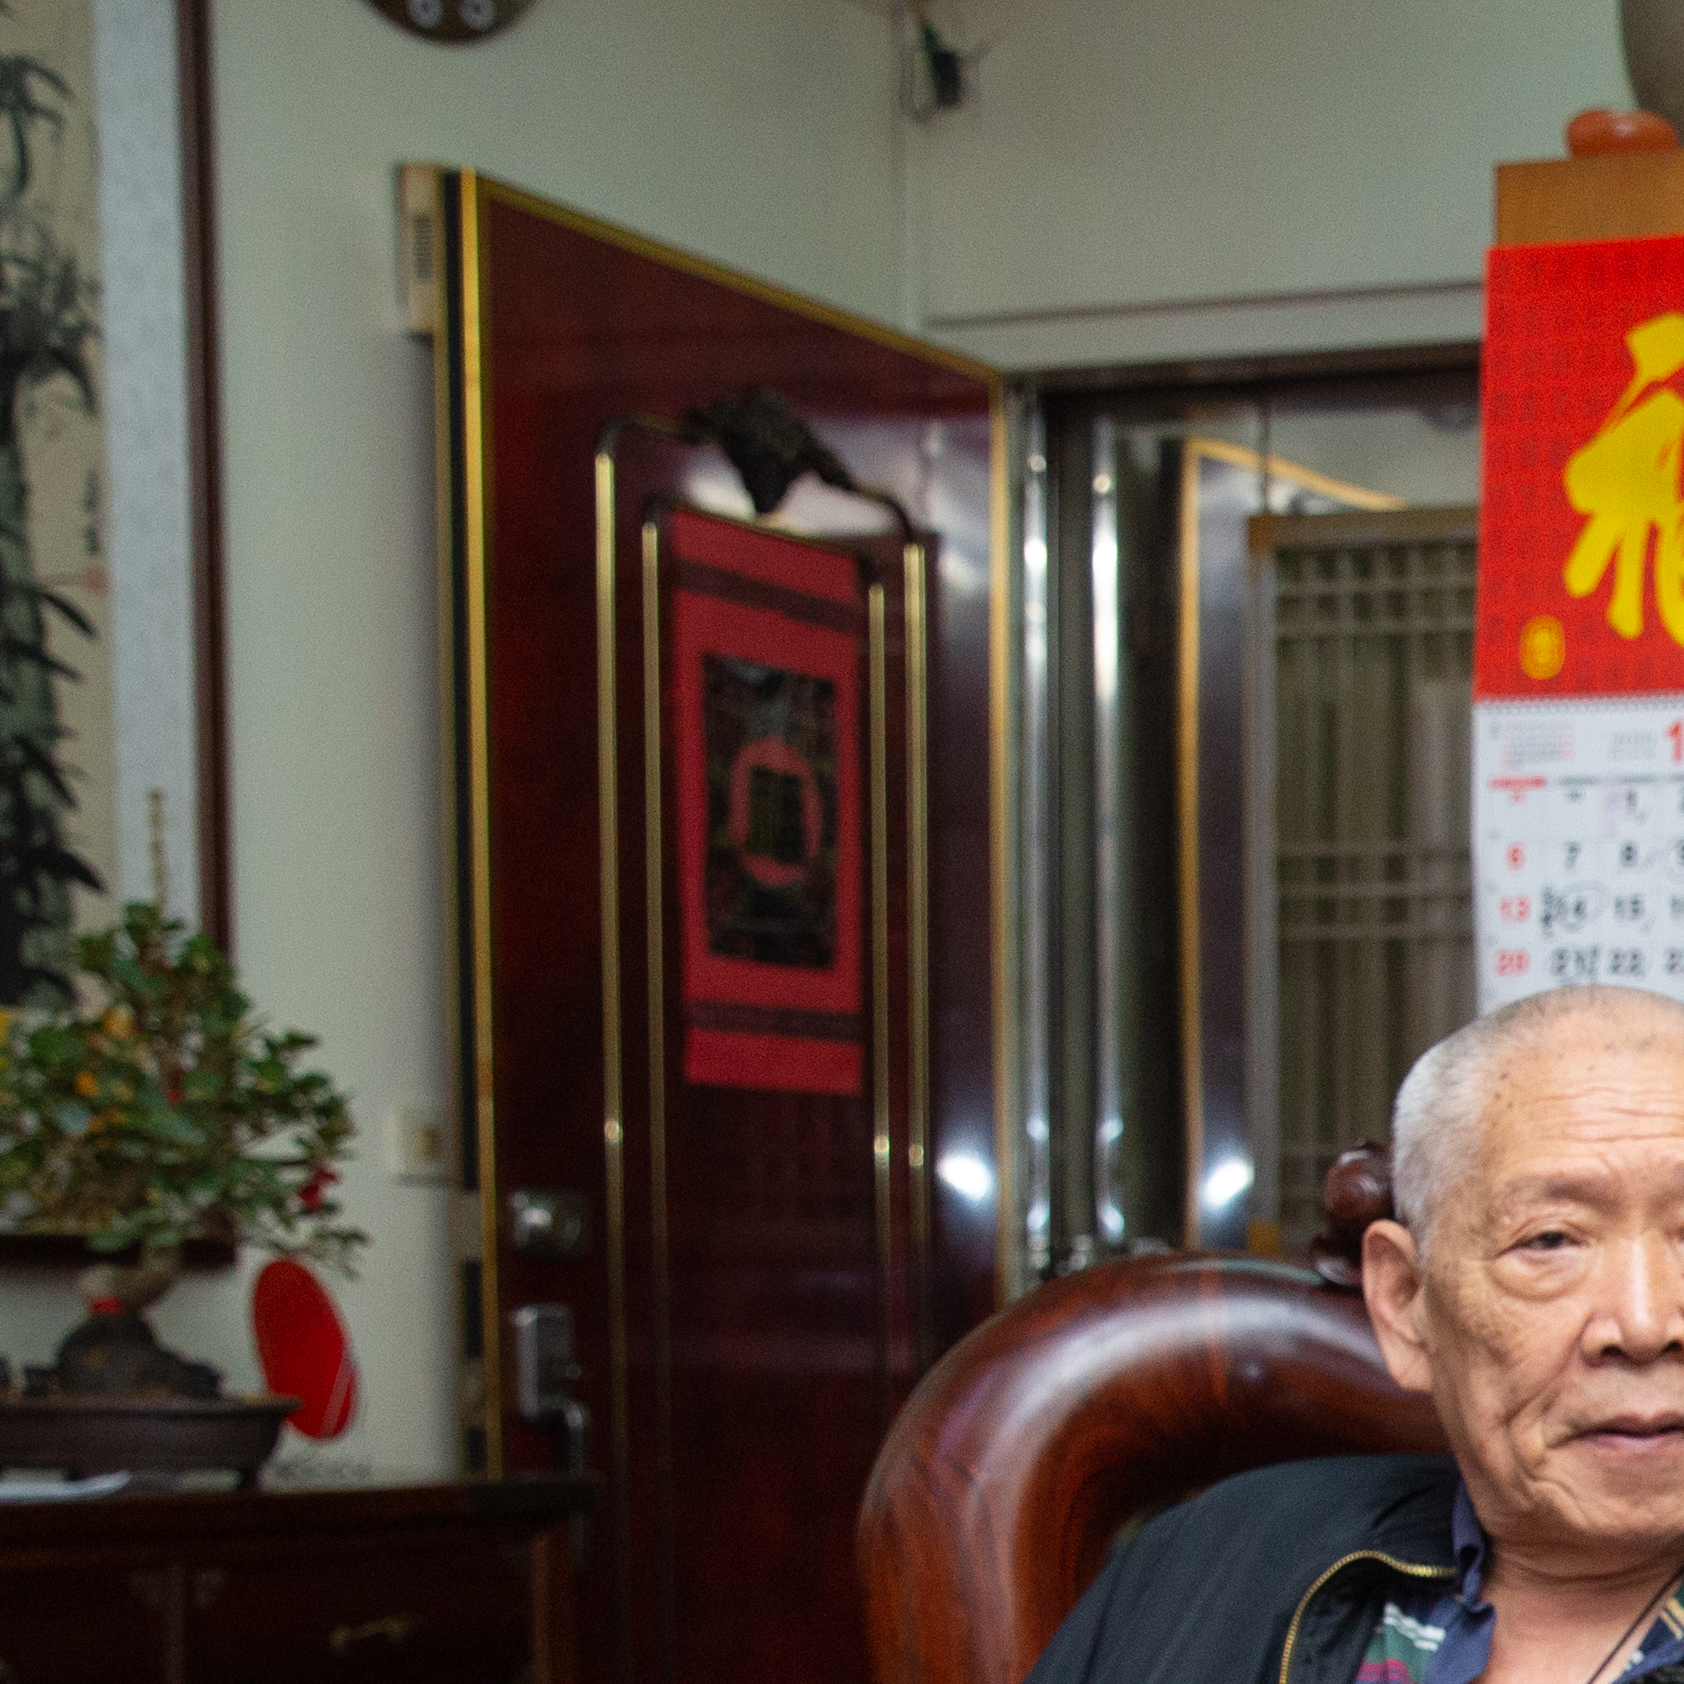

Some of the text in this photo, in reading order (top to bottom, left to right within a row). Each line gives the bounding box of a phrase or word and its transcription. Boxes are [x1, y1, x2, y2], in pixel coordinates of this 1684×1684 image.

[1507, 844, 1524, 869] 6
[1566, 841, 1581, 869] 7
[1621, 843, 1637, 866] 8
[1499, 896, 1530, 922] 13
[1615, 895, 1644, 920] 15
[1609, 950, 1644, 976] 22
